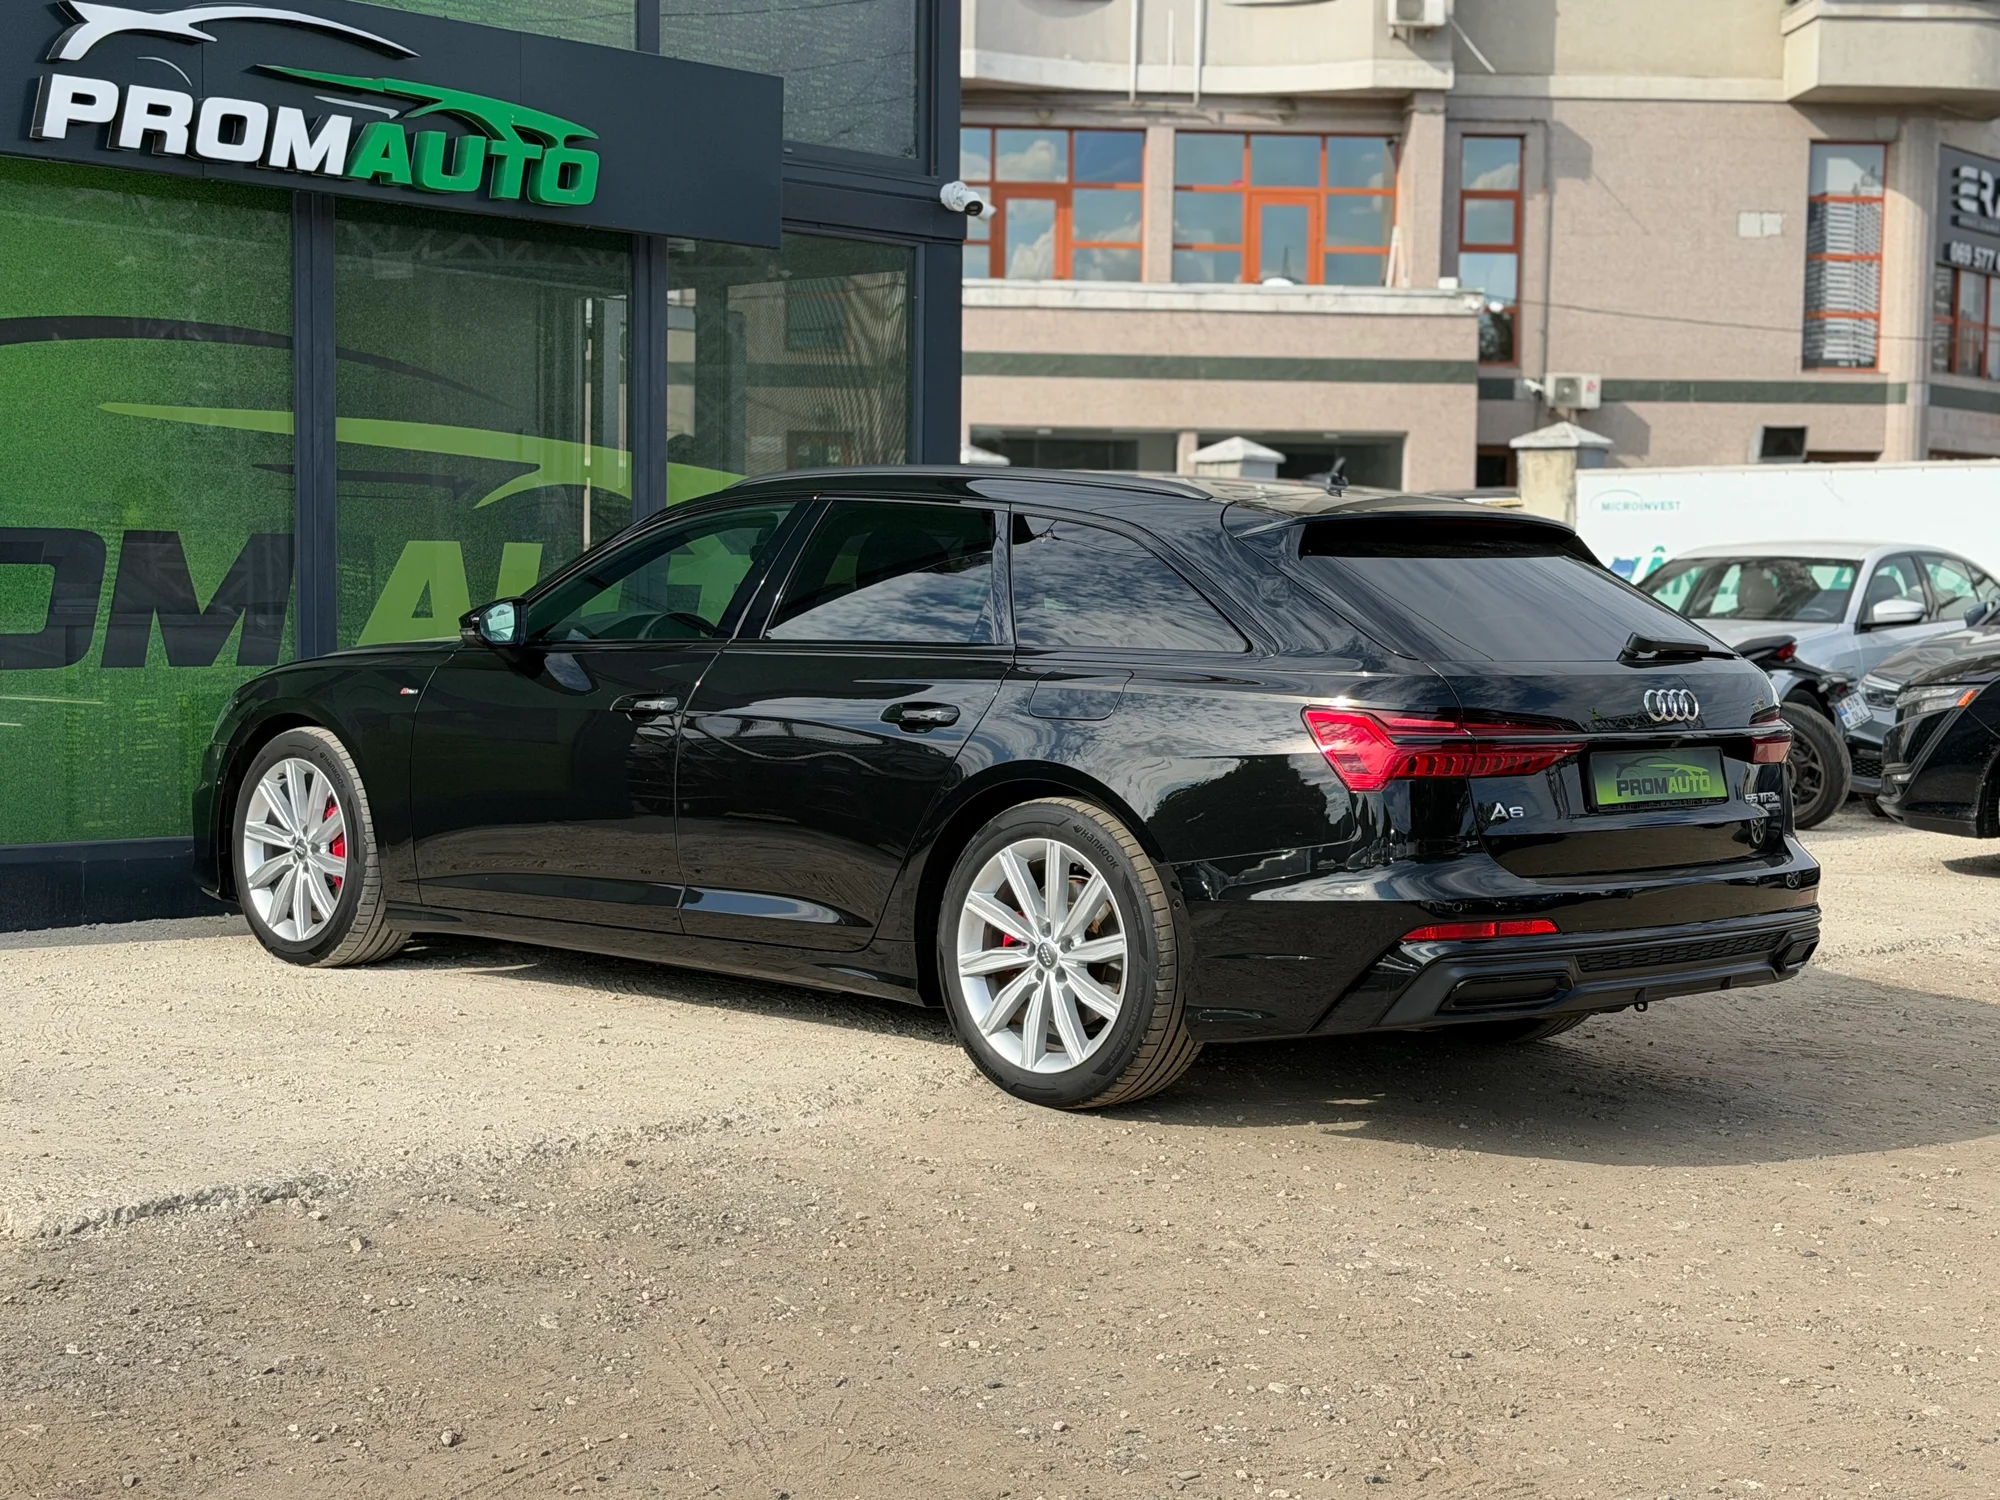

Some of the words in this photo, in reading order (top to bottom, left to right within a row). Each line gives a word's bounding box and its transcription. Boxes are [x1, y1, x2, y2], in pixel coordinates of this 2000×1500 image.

[30, 73, 600, 206] PROMAUTO
[1601, 500, 1681, 511] MICROINVEST
[1616, 775, 1711, 797] PROMAUTO
[1745, 793, 1758, 803] 55
[1490, 802, 1524, 821] A6
